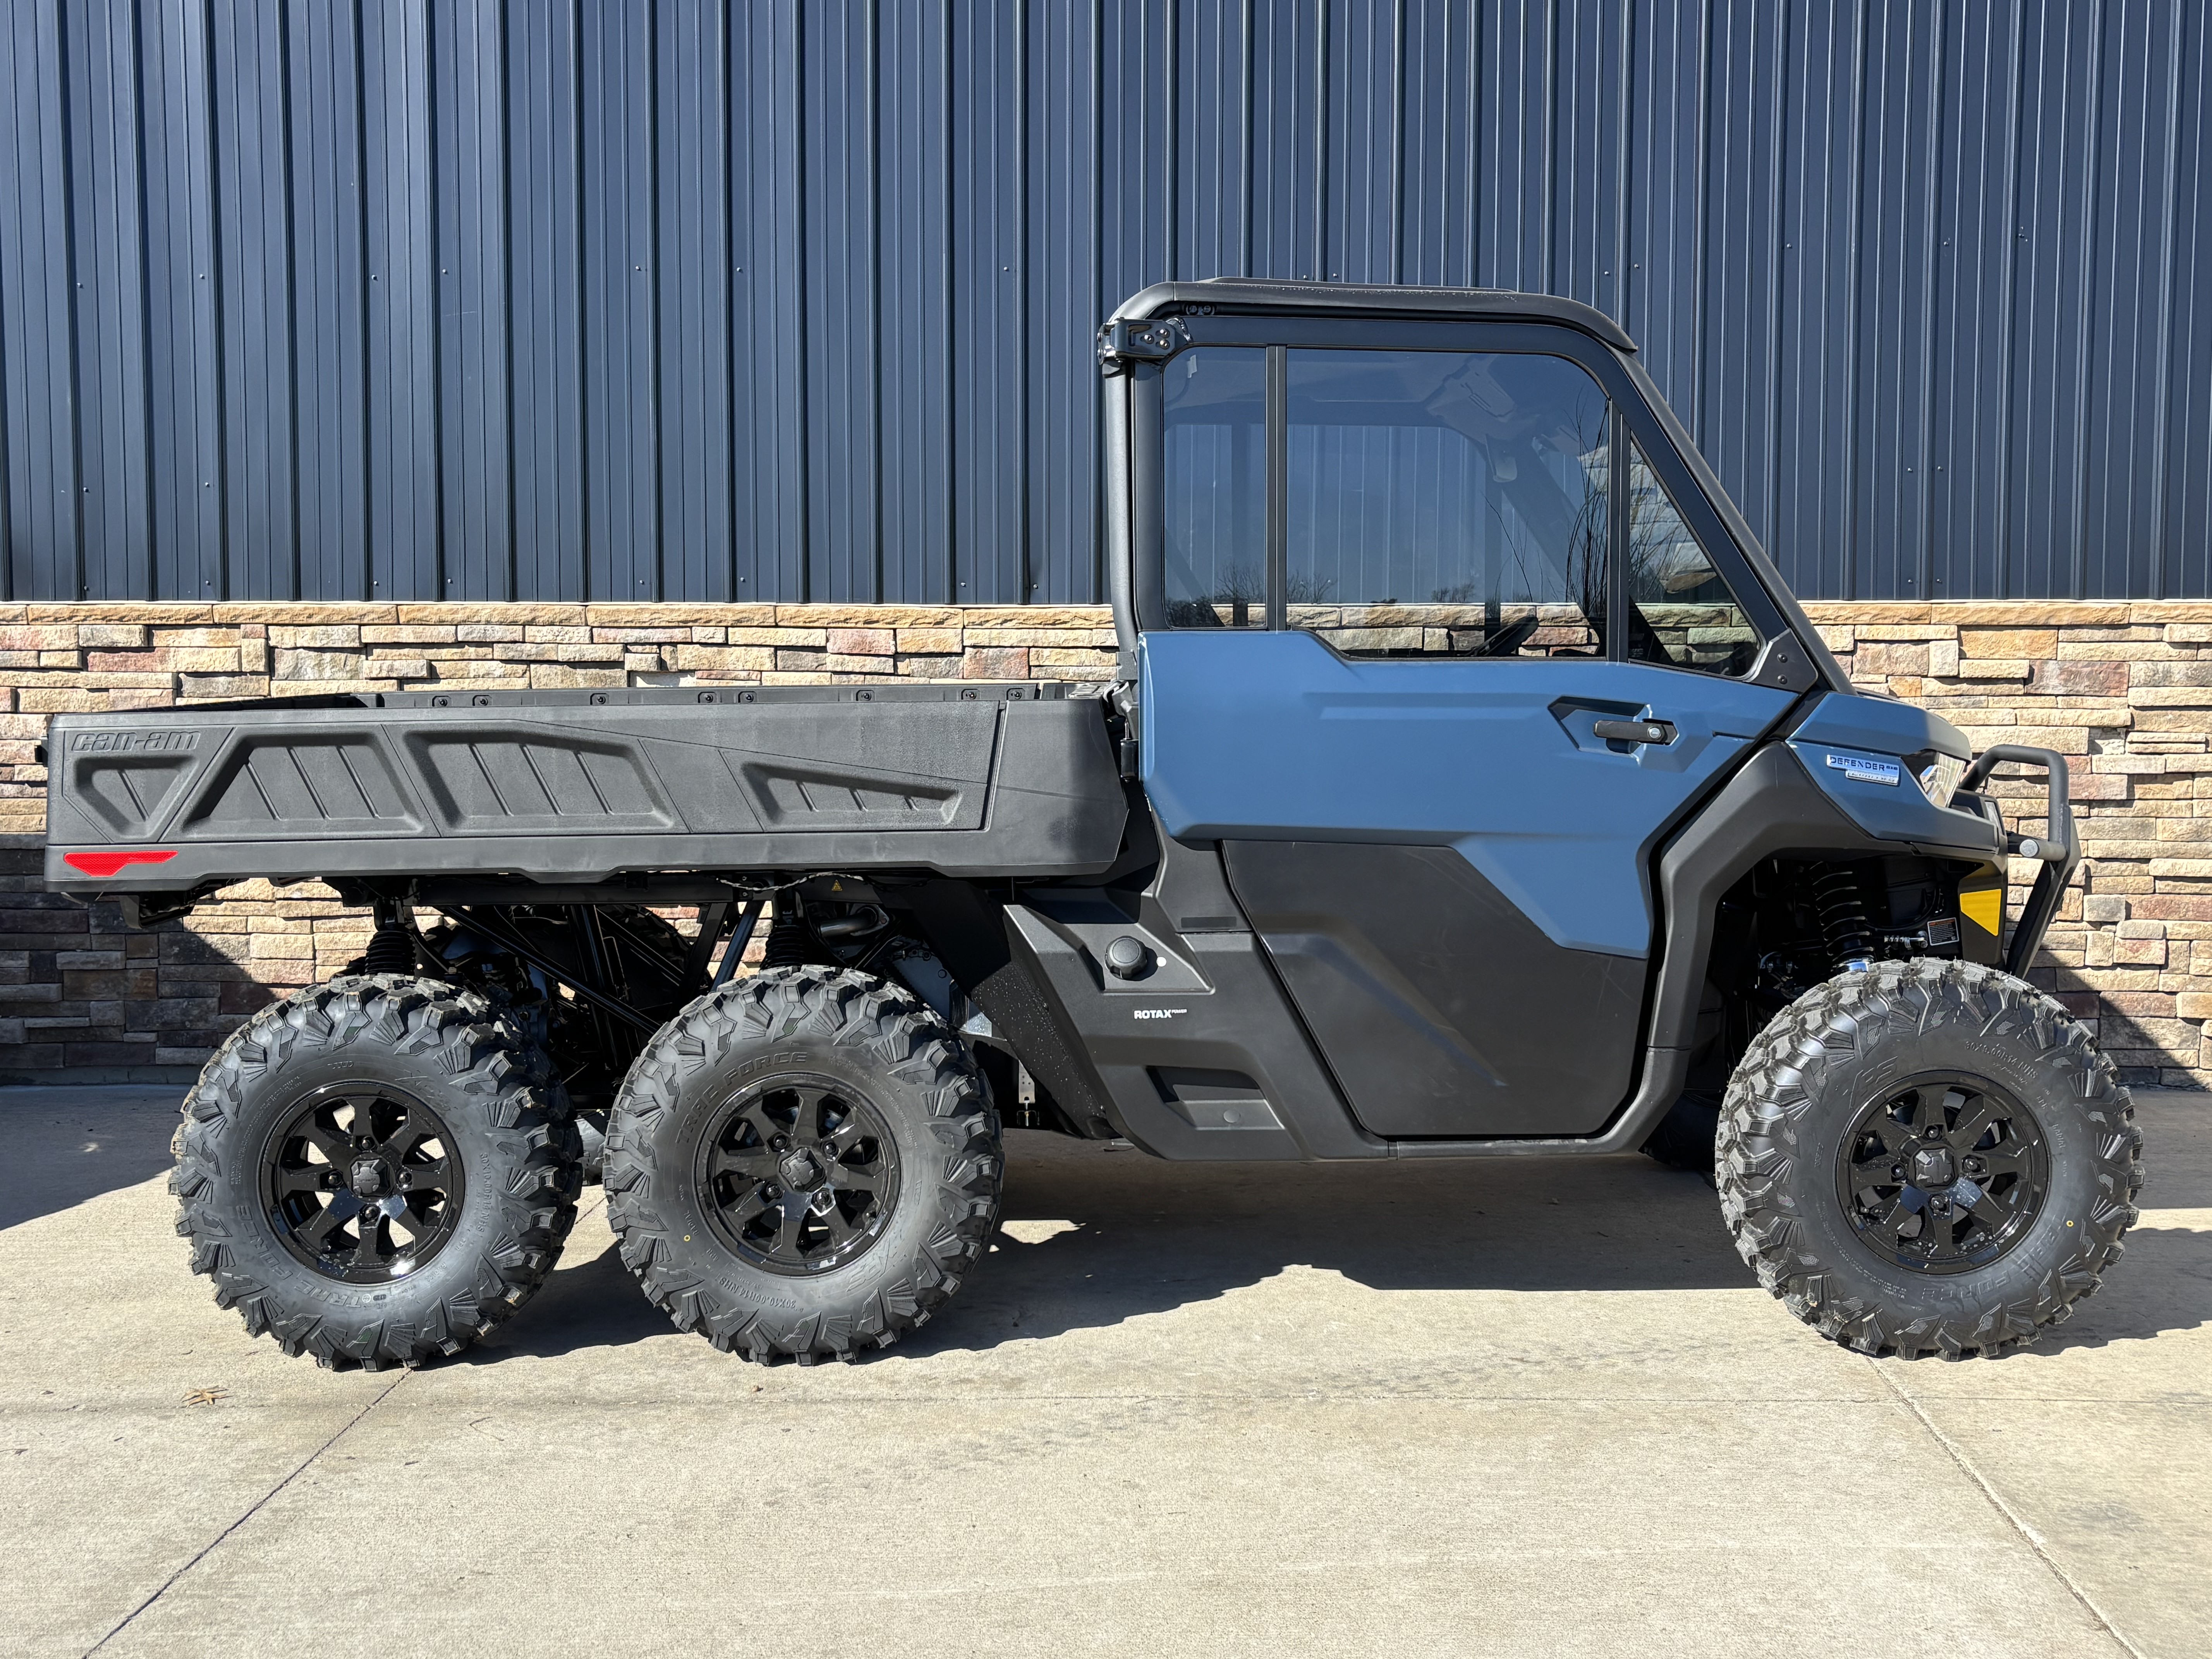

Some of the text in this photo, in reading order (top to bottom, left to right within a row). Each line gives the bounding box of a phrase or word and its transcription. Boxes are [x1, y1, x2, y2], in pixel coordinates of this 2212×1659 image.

[71, 732, 201, 752] can-am
[1831, 757, 1885, 771] DEFENDER
[1134, 1010, 1172, 1019] ROTAX
[676, 1051, 808, 1145] TRAC FORCE
[684, 1210, 700, 1236] RADIAL
[237, 1205, 362, 1308] TRAC FORCE
[719, 1276, 739, 1294] NHS
